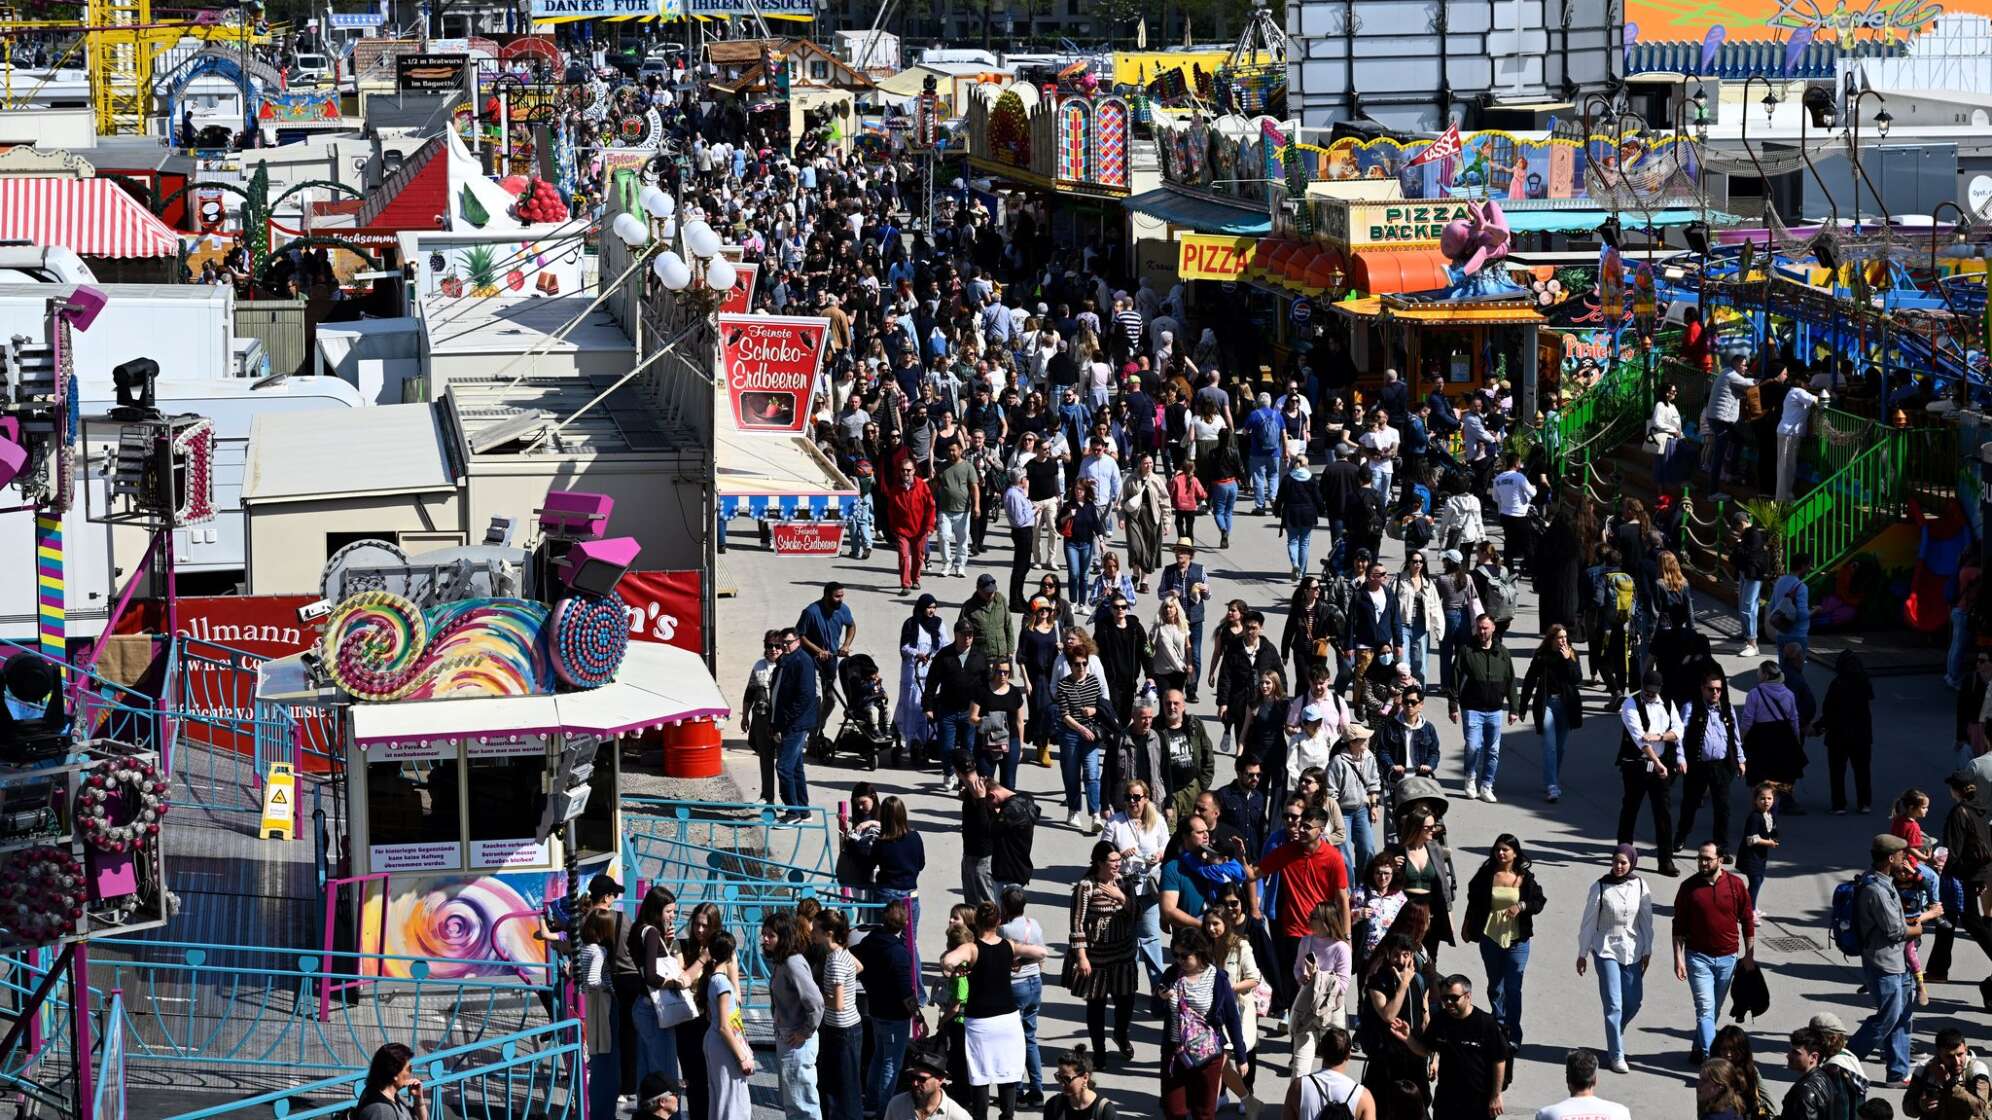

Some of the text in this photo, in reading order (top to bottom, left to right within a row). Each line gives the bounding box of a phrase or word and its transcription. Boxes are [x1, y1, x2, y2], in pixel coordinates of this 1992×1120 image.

[544, 0, 605, 11] DANKE
[692, 0, 744, 9] IHREN
[1424, 127, 1460, 160] KASSE
[1386, 206, 1471, 223] PIZZA
[1184, 244, 1250, 274] PIZZA
[748, 325, 792, 338] Feinste
[738, 336, 808, 362] Schoko-
[732, 360, 807, 390] Erdbeeren
